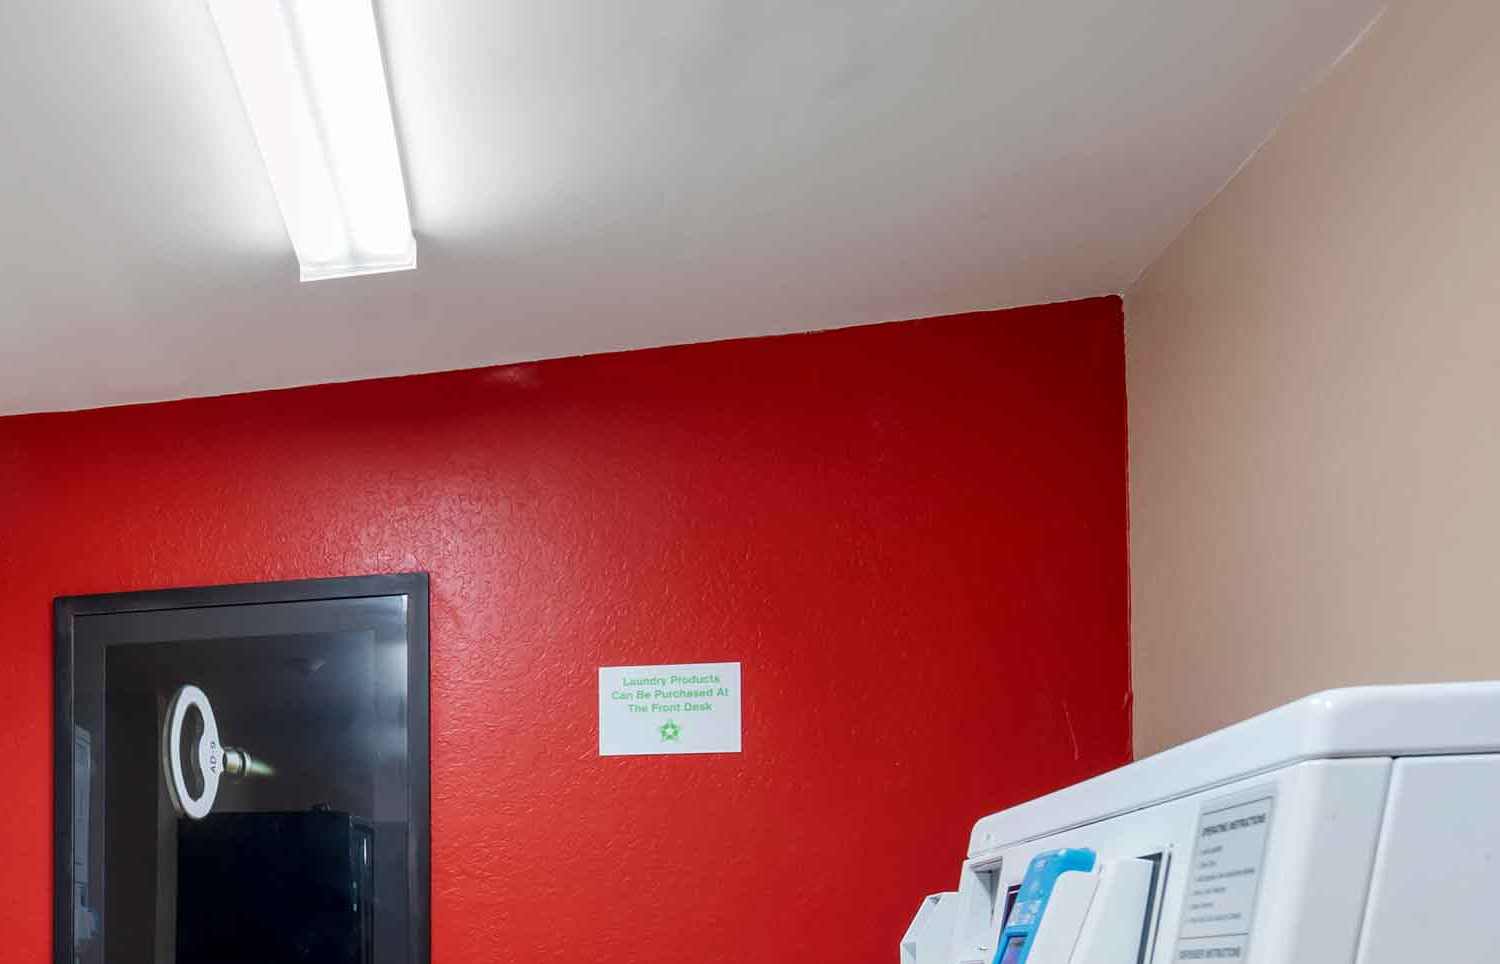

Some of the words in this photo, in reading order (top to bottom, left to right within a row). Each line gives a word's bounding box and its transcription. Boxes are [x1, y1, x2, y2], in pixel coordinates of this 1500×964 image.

[622, 676, 666, 687] Laundry
[670, 674, 720, 685] Products
[611, 690, 634, 700] Can
[636, 690, 652, 699] Be
[654, 688, 713, 699] Purchased
[627, 703, 648, 712] The
[652, 703, 681, 712] Front
[684, 702, 713, 711] Desk
